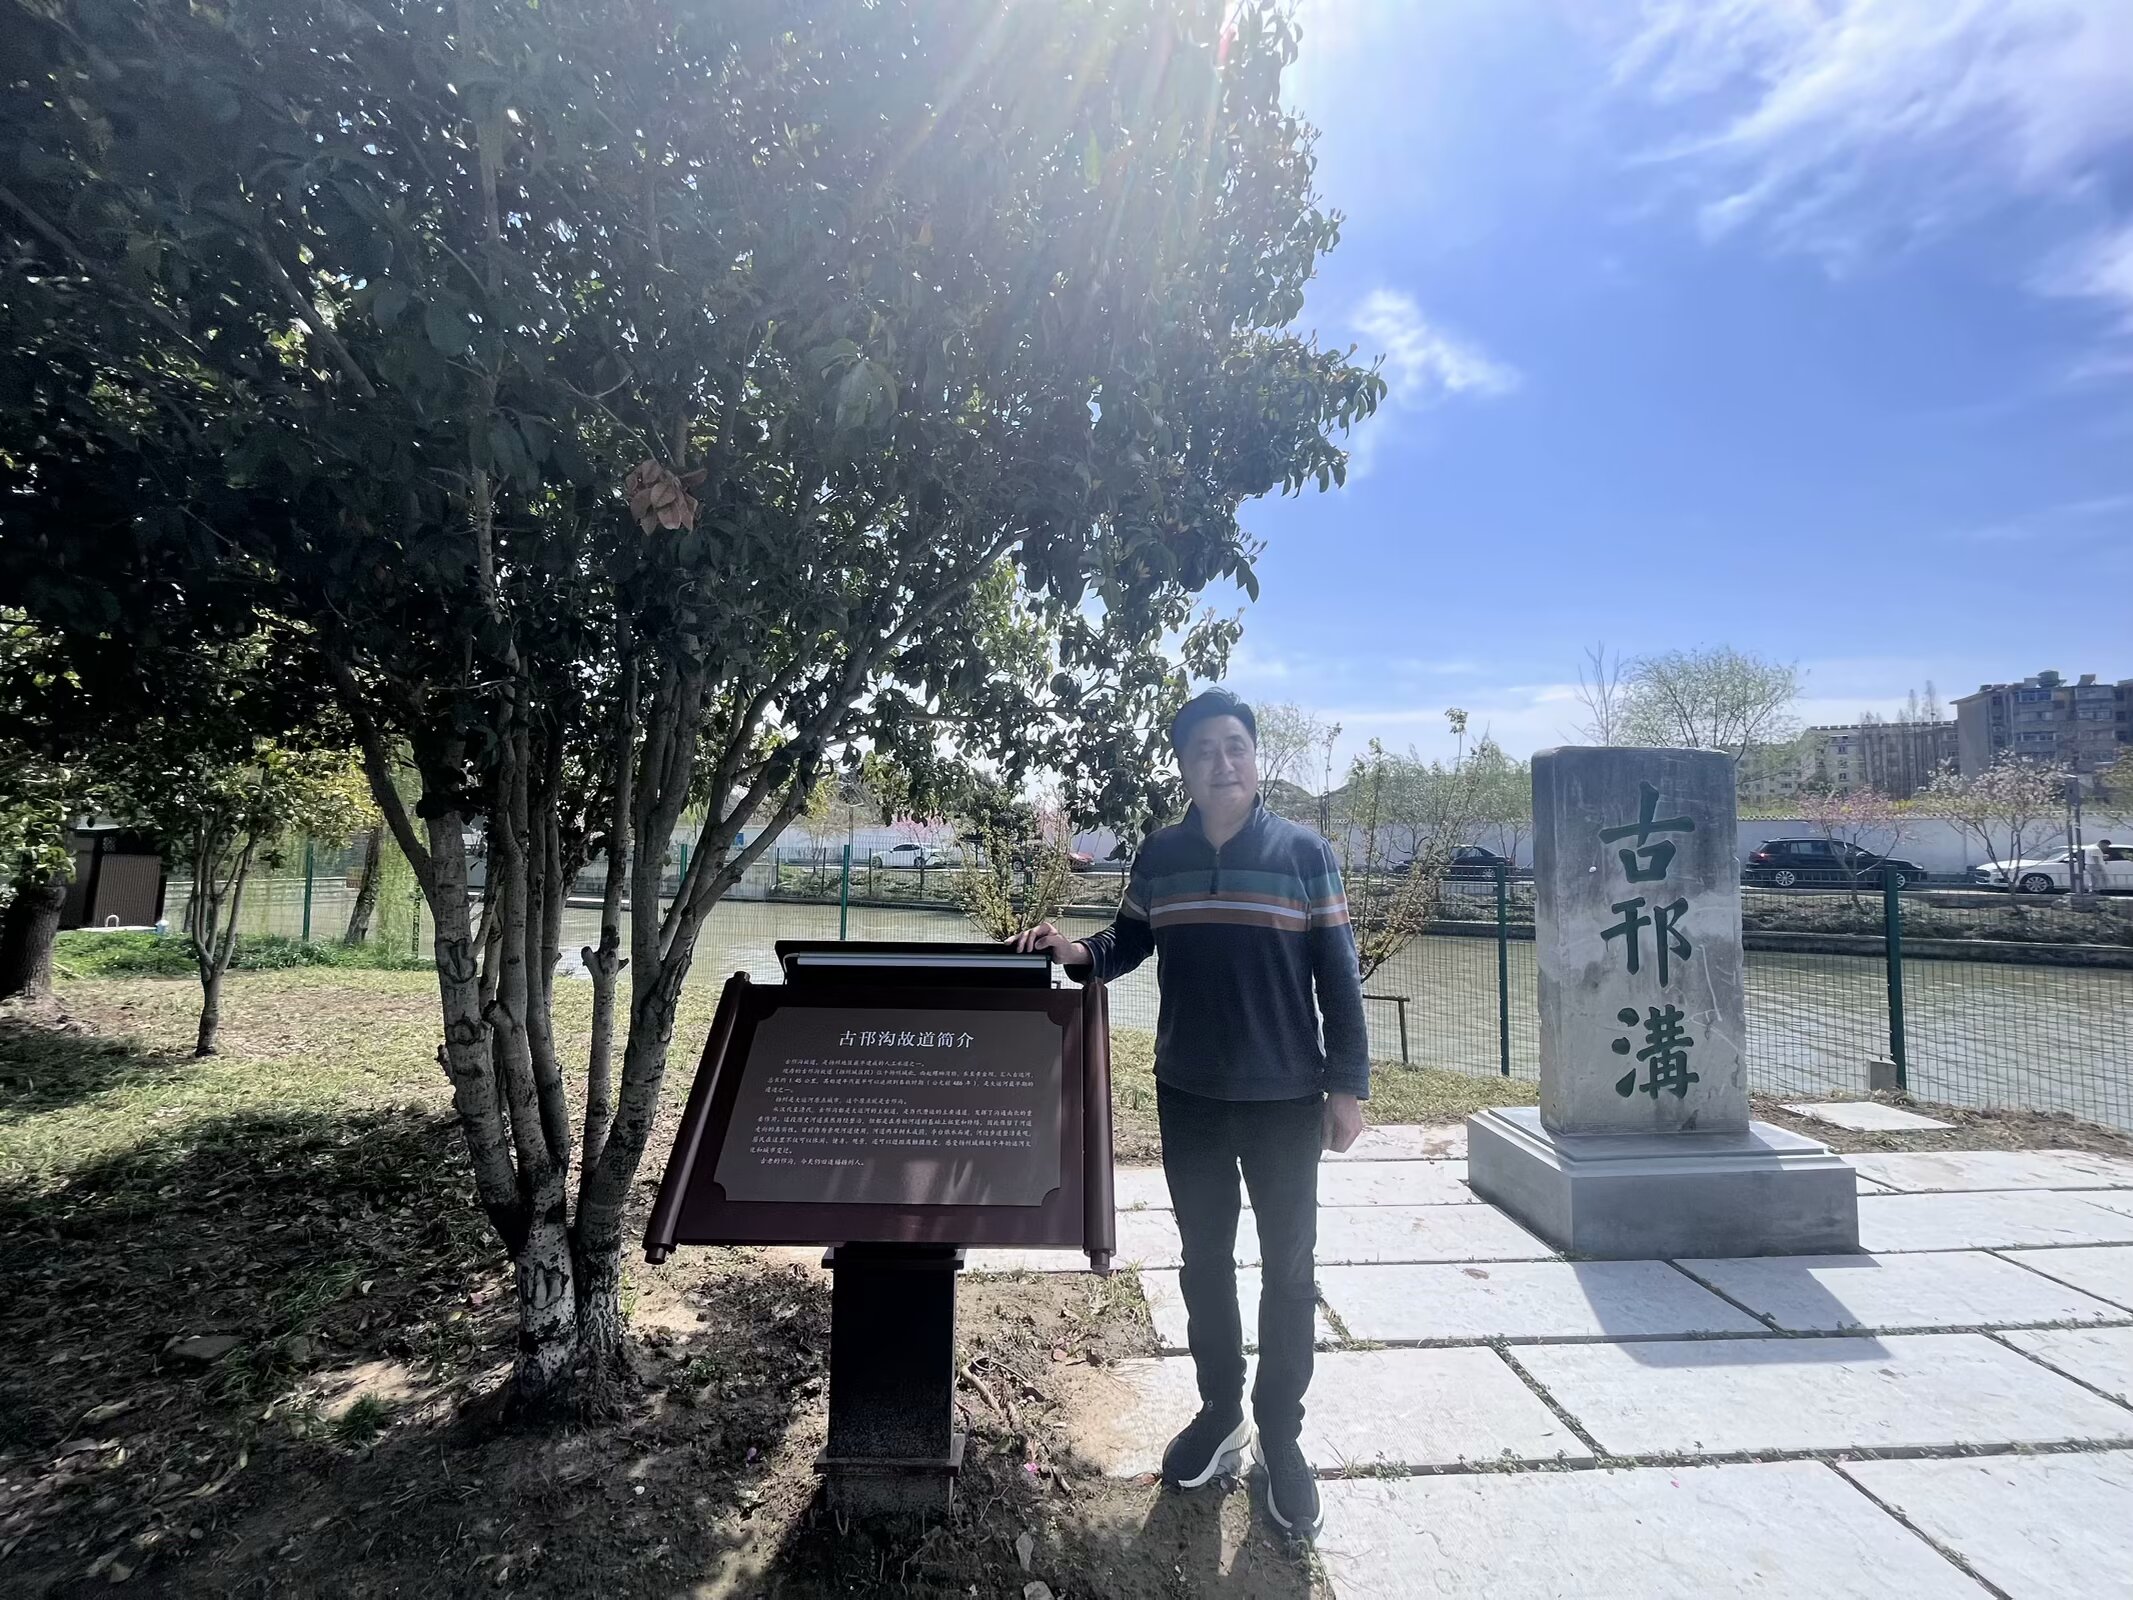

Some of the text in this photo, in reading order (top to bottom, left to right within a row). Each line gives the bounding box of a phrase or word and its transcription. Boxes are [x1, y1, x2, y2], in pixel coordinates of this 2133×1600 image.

[1599, 781, 1700, 1100] 古邗溝
[839, 1030, 975, 1048] 古邗沟故道简介
